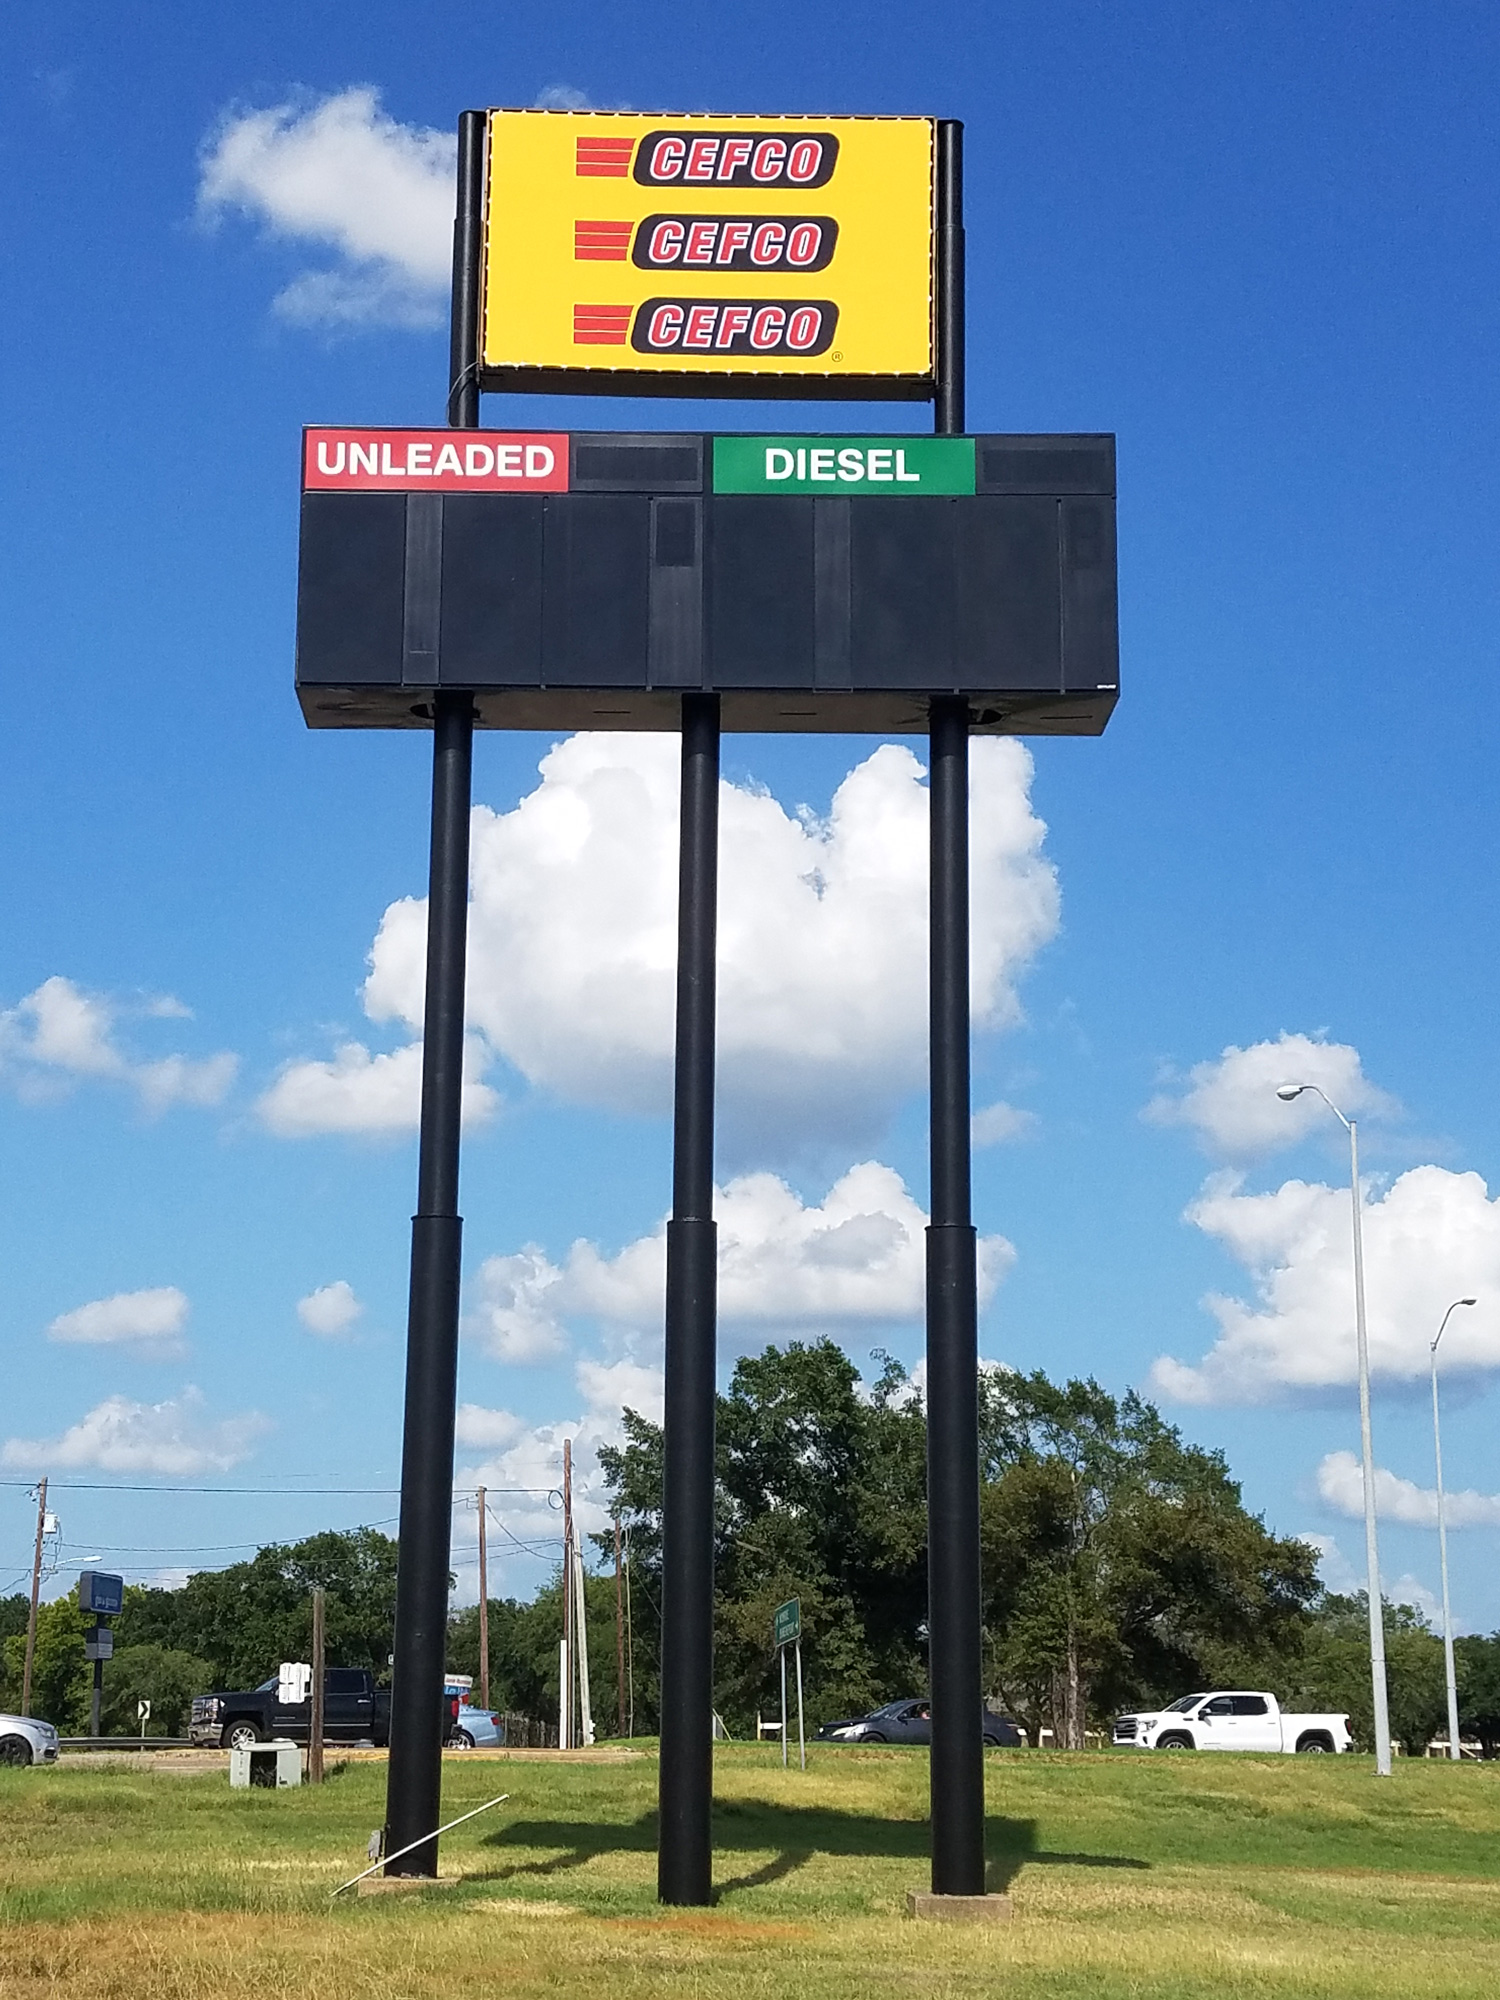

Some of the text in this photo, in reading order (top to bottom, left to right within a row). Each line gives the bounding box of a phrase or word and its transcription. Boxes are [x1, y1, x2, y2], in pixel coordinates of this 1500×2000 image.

[649, 137, 822, 182] CEFCO
[648, 221, 822, 266] CEFCO
[647, 304, 822, 350] CEFCO
[316, 442, 555, 479] UNLEADED
[764, 447, 920, 483] DIESEL
